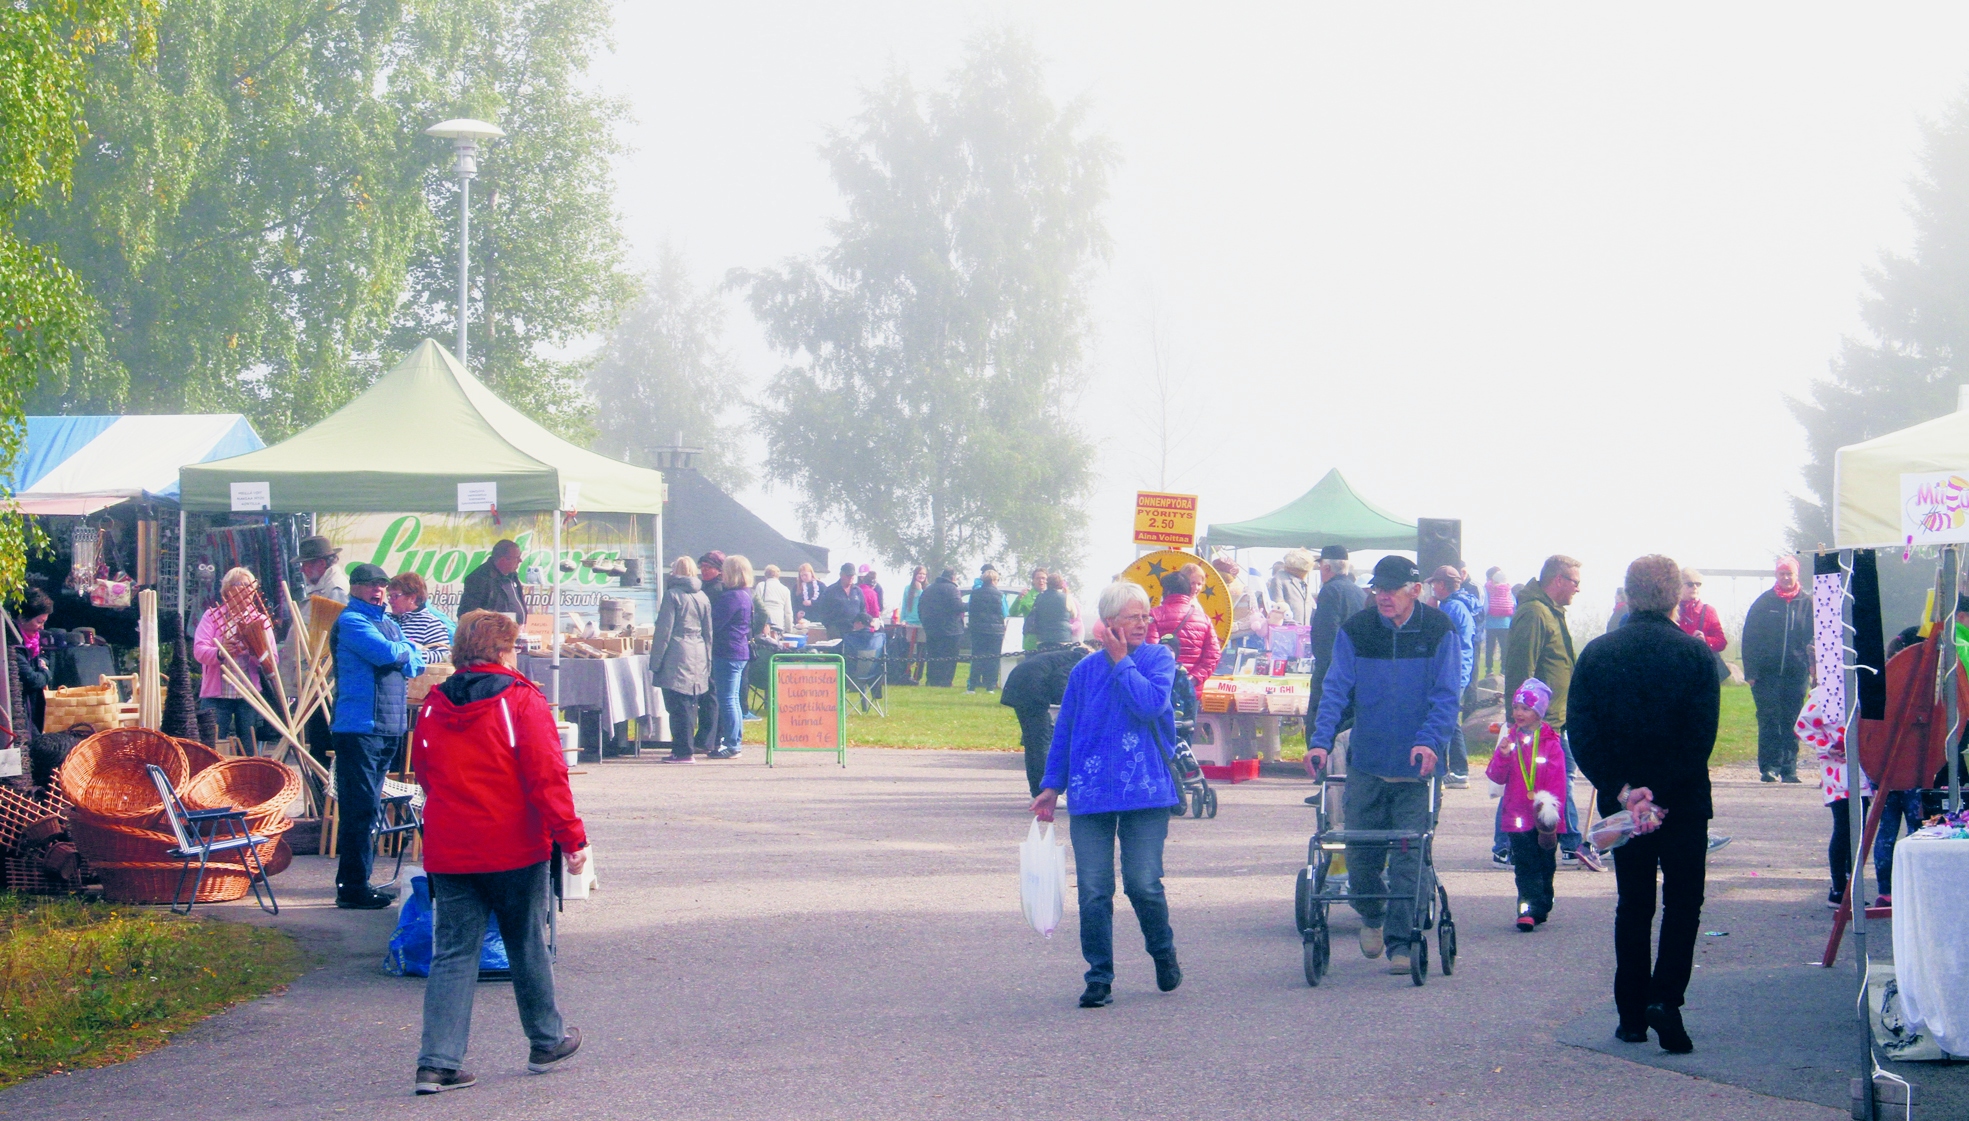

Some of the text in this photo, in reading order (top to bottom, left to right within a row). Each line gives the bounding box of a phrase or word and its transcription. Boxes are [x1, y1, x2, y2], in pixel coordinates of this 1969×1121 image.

[1138, 496, 1193, 509] ONNENPYÖRÄ
[1137, 509, 1193, 519] PYÖRITYS
[1148, 518, 1174, 529] 2.50
[1138, 532, 1189, 543] Aina Voittaa
